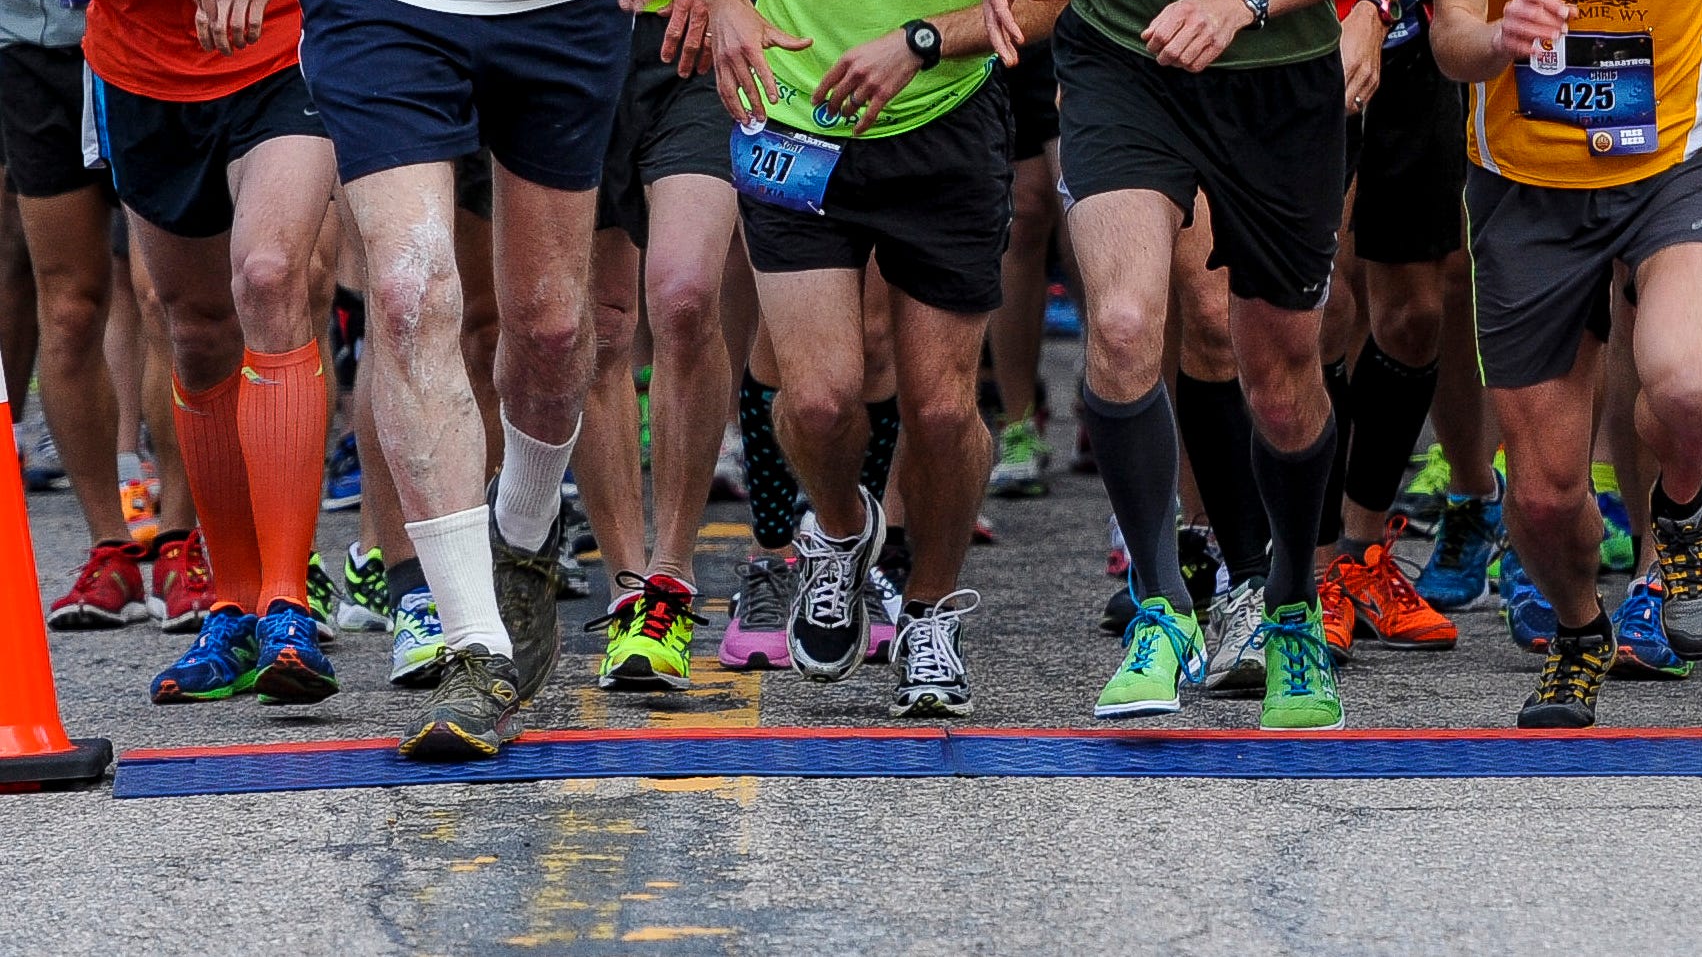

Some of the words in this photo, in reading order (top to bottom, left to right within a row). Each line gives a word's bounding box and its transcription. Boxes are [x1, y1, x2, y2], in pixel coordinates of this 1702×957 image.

[1574, 6, 1614, 21] MIE,
[1620, 9, 1648, 22] WY
[1600, 58, 1650, 67] MARATHON
[1555, 82, 1616, 112] 425
[1620, 129, 1643, 137] FREE
[1621, 137, 1645, 145] BEER
[749, 144, 796, 184] 247
